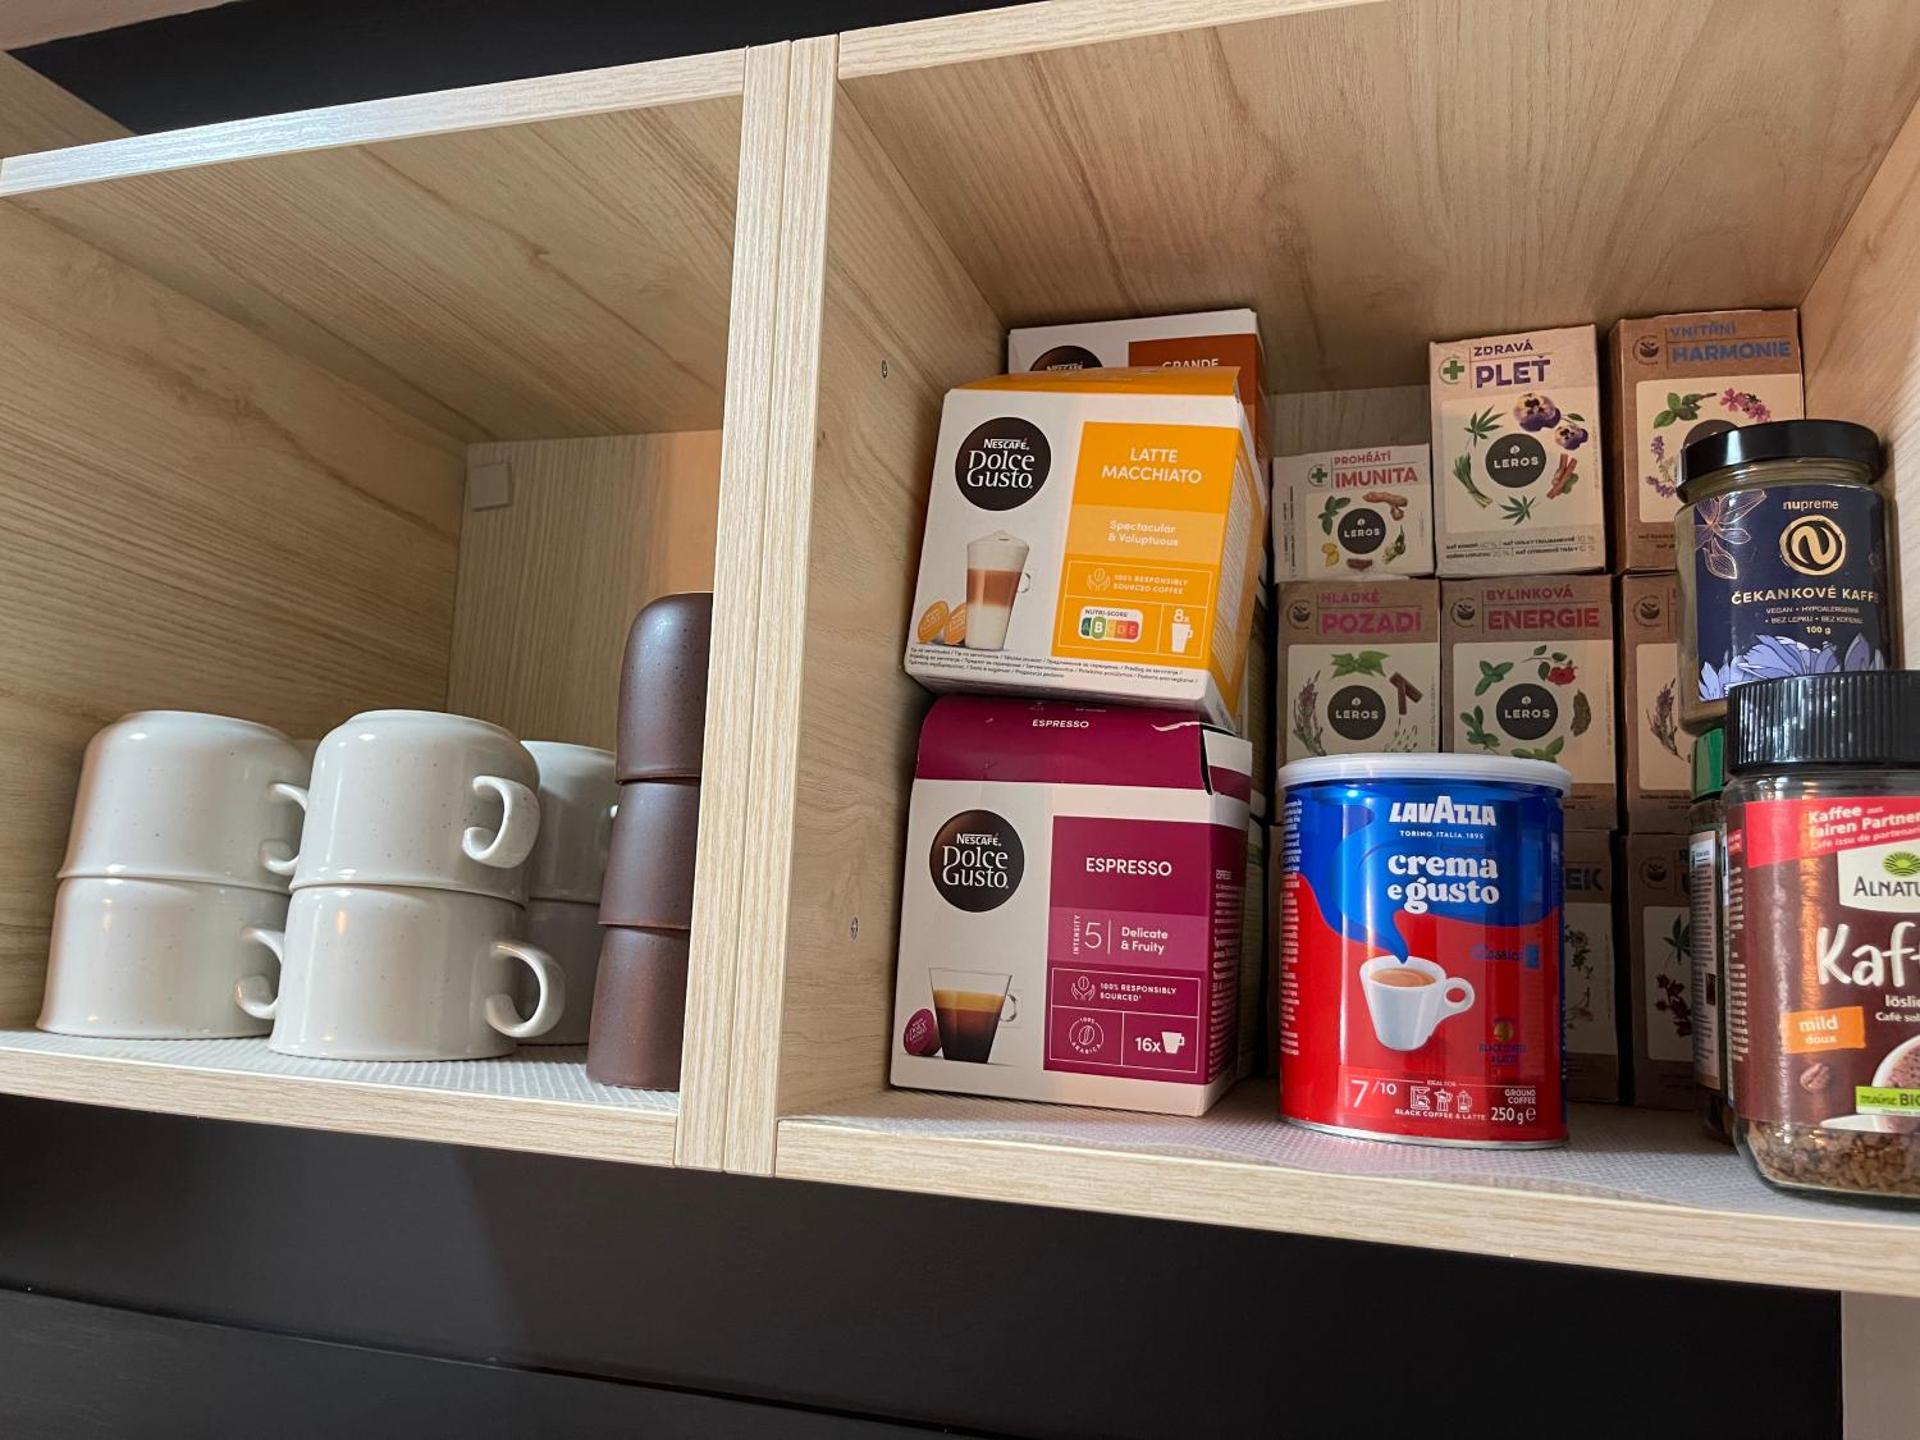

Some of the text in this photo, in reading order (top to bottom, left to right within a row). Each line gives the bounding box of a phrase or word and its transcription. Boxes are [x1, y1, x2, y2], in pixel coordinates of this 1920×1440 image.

[1473, 339, 1533, 357] ZDRAVÁ
[1671, 341, 1792, 364] HARMONIE
[1475, 355, 1551, 389] PLEŤ
[968, 450, 1035, 471] Dolce
[1130, 448, 1179, 463] LATTE
[1494, 456, 1540, 469] LEROS
[967, 468, 1033, 489] Gusto
[1101, 464, 1202, 484] MACCHIATO
[1335, 467, 1418, 489] IMUNITA
[1783, 500, 1839, 511] nupreme
[1109, 520, 1177, 534] Spectacular
[1343, 528, 1381, 538] LEROS
[1107, 532, 1179, 547] & Voluptuous
[1321, 589, 1380, 604] HLADKÉ
[1486, 584, 1573, 600] BYLINKOVÁ
[1731, 587, 1837, 605] ČEKANKOVÉ
[1084, 609, 1128, 618] NUTRI-SCORE
[1487, 607, 1600, 631] ENERGIE
[1322, 610, 1422, 634] POZADÍ
[1805, 626, 1823, 635] 100
[1335, 710, 1379, 720] LEROS
[1504, 708, 1550, 719] LEROS
[1032, 718, 1090, 729] ESPRESSO
[1388, 795, 1497, 827] LAVAZZA
[1808, 805, 1862, 825] Kaffee
[1809, 821, 1858, 839] fairen
[1857, 834, 1871, 843] de
[942, 846, 1008, 869] Dolce
[1085, 857, 1172, 876] ESPRESSO
[1388, 854, 1498, 879] crema
[942, 866, 1009, 889] Gusto
[1387, 876, 1500, 915] e gusto
[1073, 915, 1081, 955] INTENSITY
[1084, 922, 1102, 949] 5
[1121, 926, 1168, 940] Delicate
[1120, 940, 1165, 956] & Fruity
[1816, 921, 1920, 987] Kaf
[1121, 984, 1177, 995] RESPONSIBLY
[1799, 1016, 1840, 1031] mild
[1135, 1037, 1162, 1053] 16x
[1505, 1089, 1536, 1097] GROUND
[1508, 1096, 1536, 1104] COFFEE
[1395, 1108, 1420, 1116] BLACK
[1423, 1111, 1454, 1119] COFFEE
[1462, 1113, 1486, 1121] LATTE
[1491, 1107, 1515, 1121] 250
